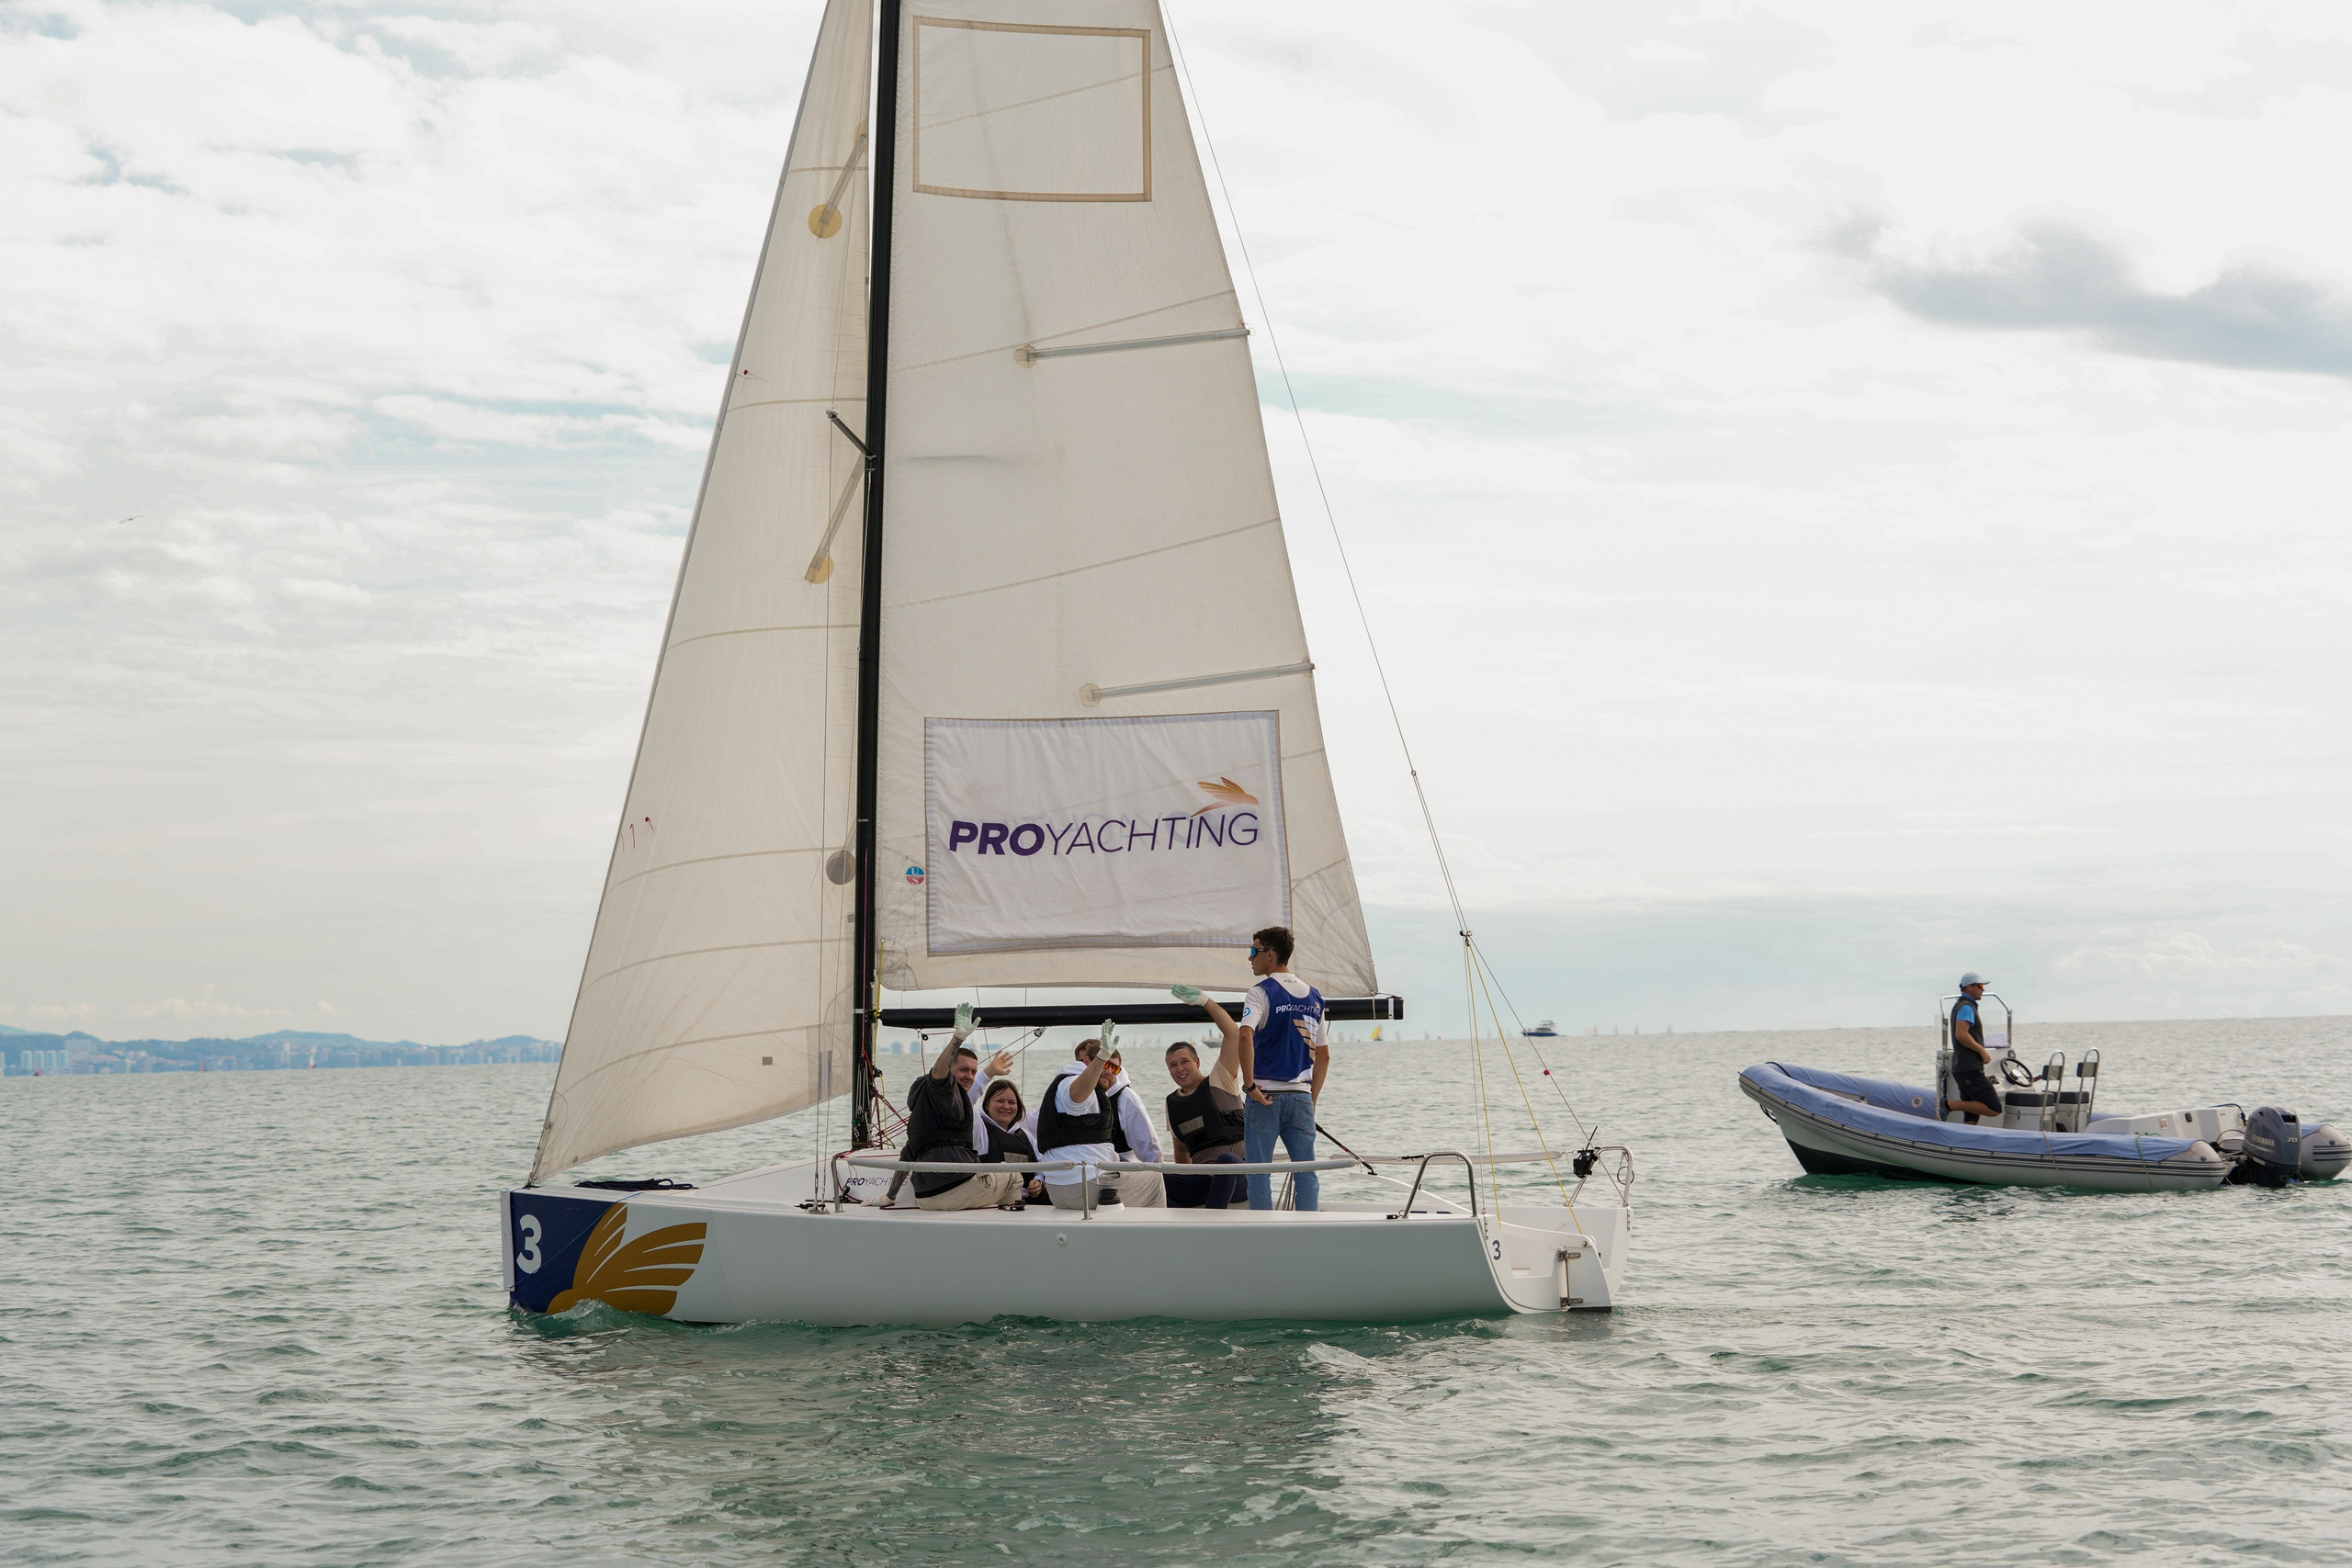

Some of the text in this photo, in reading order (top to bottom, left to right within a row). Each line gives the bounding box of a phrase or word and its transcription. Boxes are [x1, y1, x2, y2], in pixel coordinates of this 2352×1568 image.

[949, 812, 1259, 856] PROYACHTING
[845, 1177, 909, 1187] PROYACHTG
[516, 1213, 542, 1274] 3
[1492, 1239, 1501, 1260] 3
